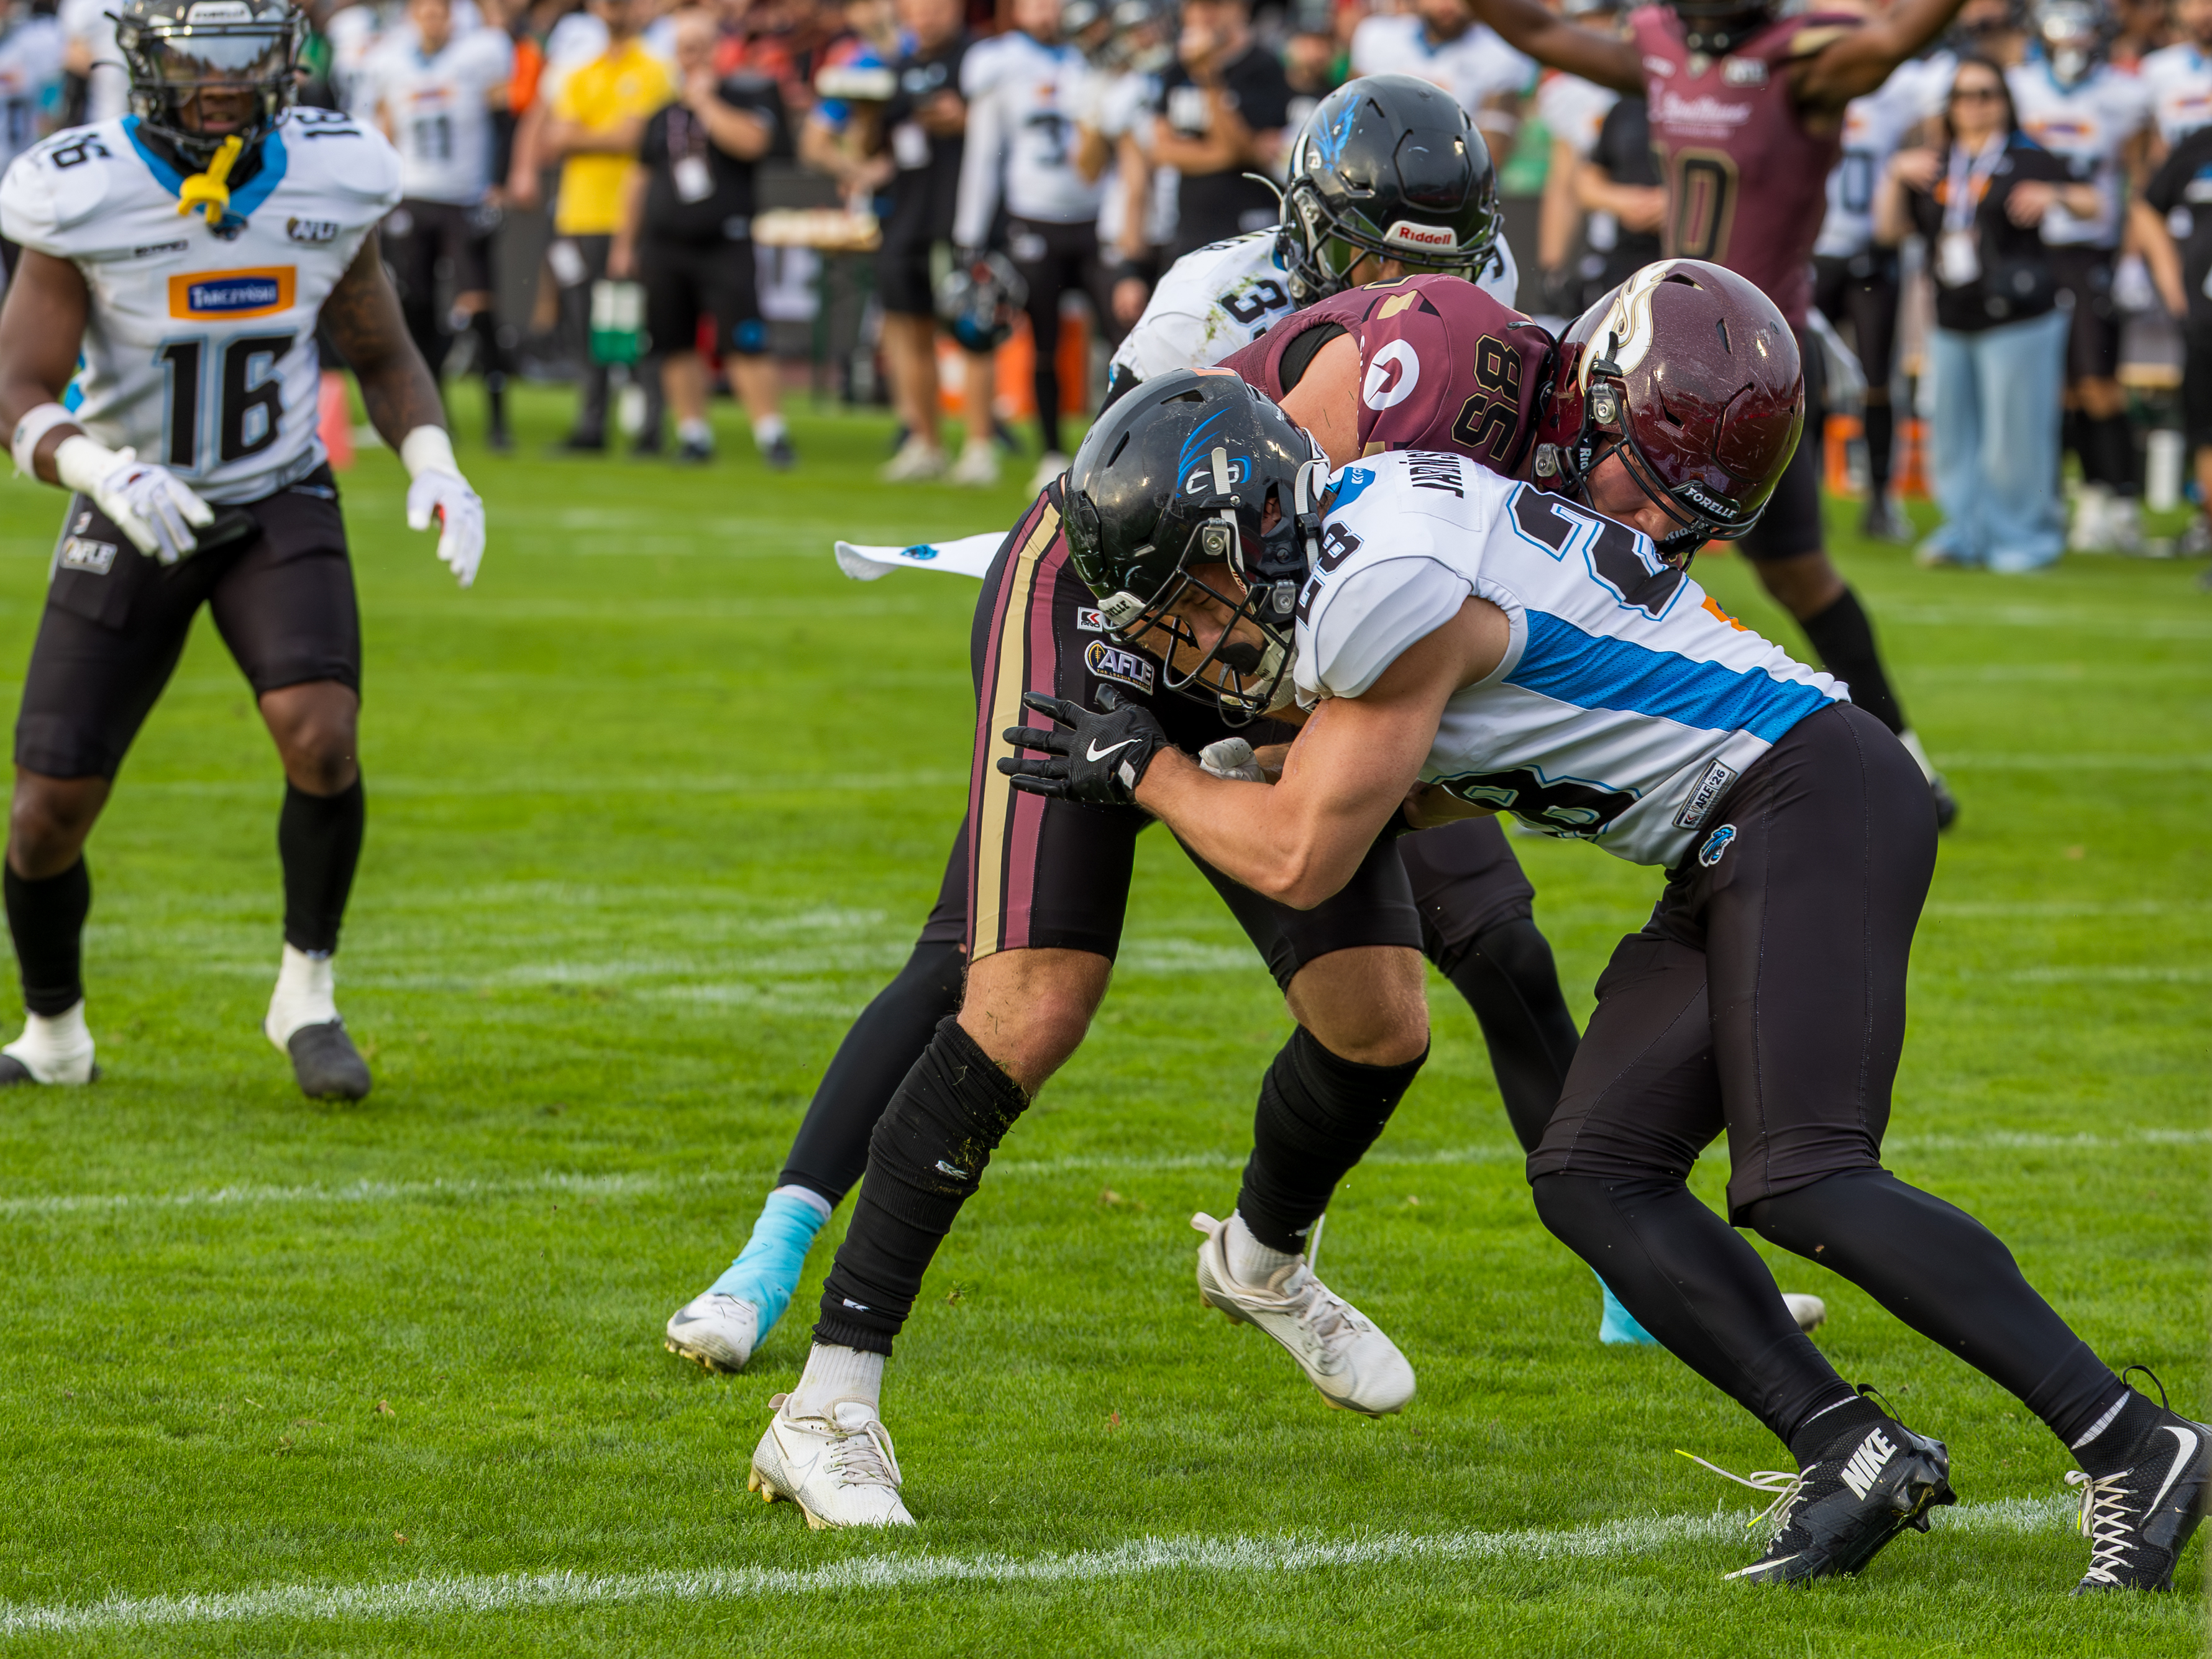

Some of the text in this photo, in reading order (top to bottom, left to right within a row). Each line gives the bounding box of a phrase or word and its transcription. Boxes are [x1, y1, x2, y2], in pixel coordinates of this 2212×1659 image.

[1399, 226, 1452, 245] Riddell
[1220, 279, 1288, 340] 3
[155, 331, 297, 473] 16
[1684, 487, 1738, 519] FORELLE
[1296, 521, 1364, 629] 28
[1105, 600, 1130, 617] RELLE
[1097, 649, 1153, 686] AFLE
[1694, 785, 1714, 809] AFLE
[1840, 1427, 1898, 1501] NIKE
